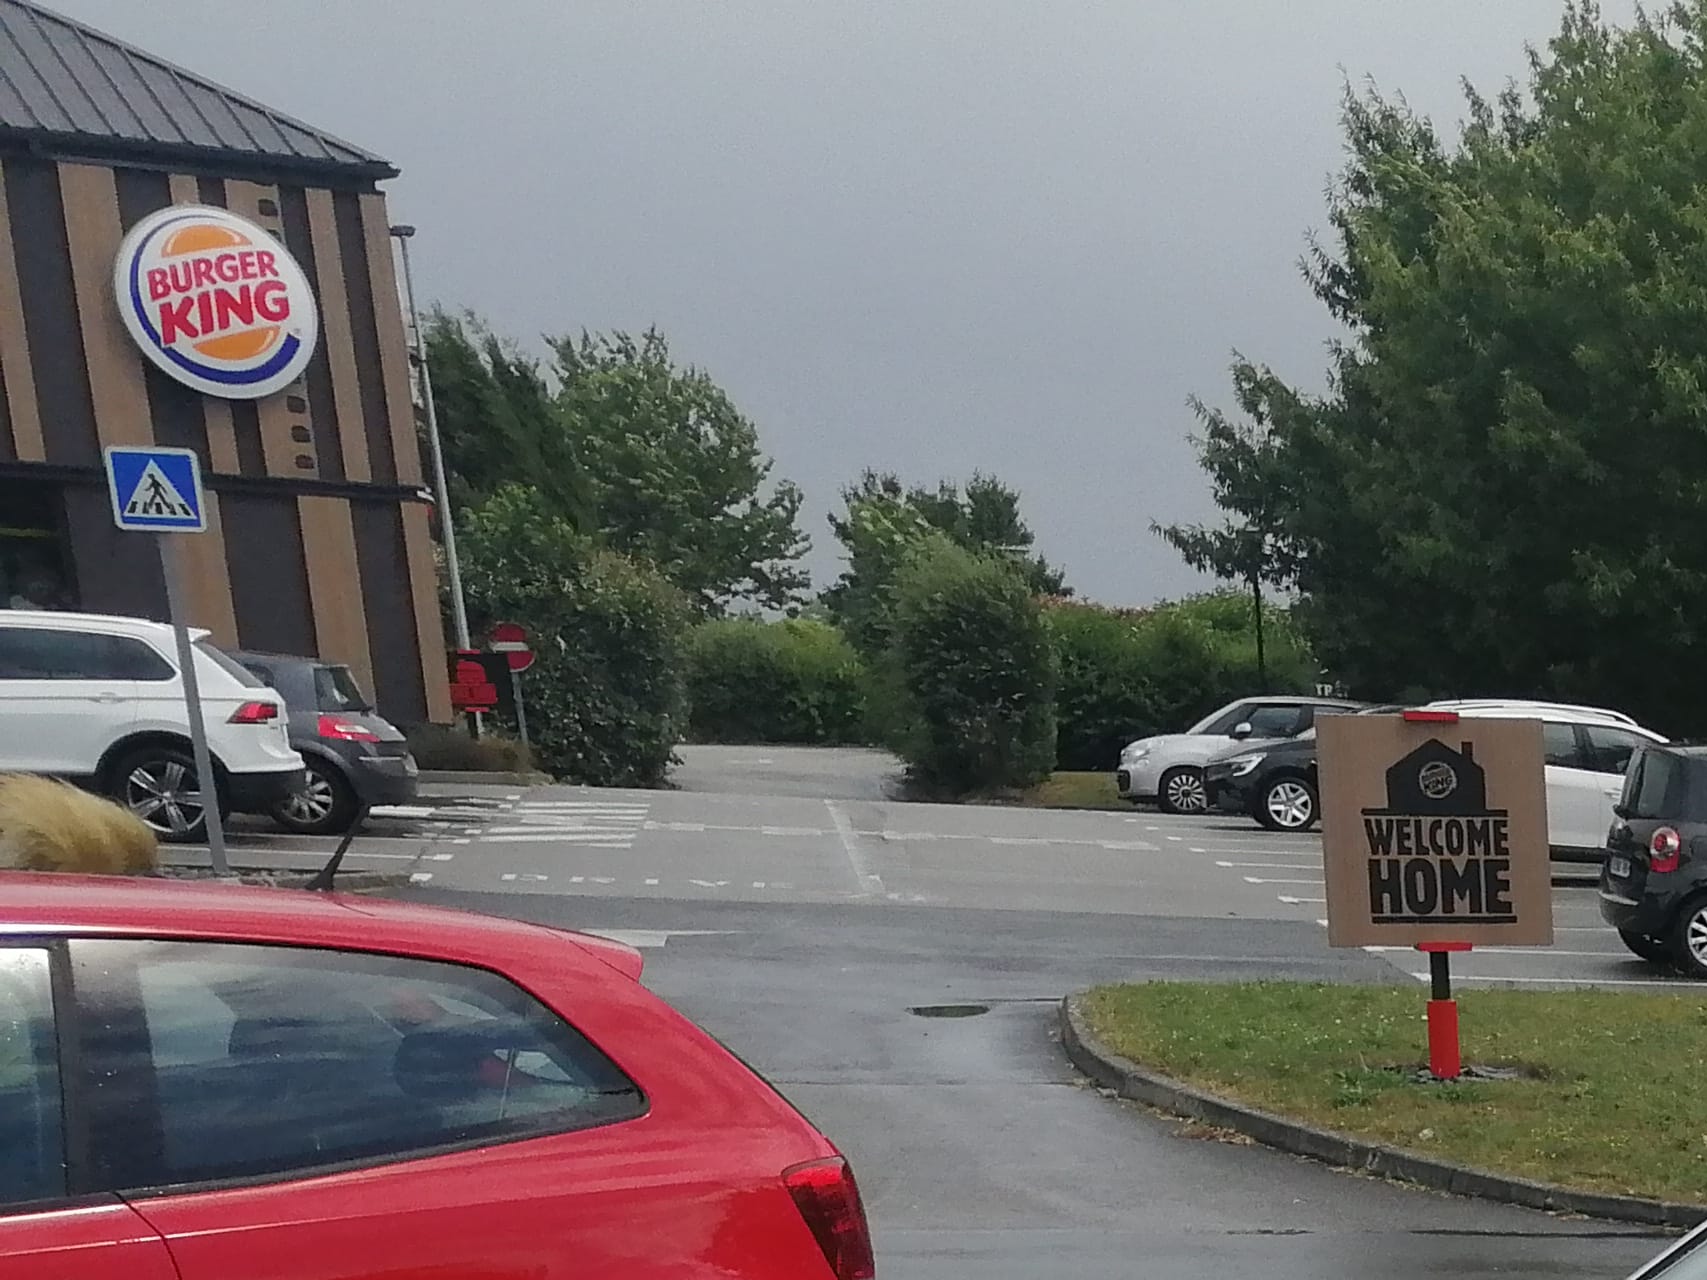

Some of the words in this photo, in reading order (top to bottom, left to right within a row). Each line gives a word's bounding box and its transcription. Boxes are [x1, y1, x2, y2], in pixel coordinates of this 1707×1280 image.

[147, 250, 279, 301] BURGER
[159, 280, 290, 345] KING
[1365, 819, 1510, 856] WELCOME
[1368, 858, 1513, 915] HOME
